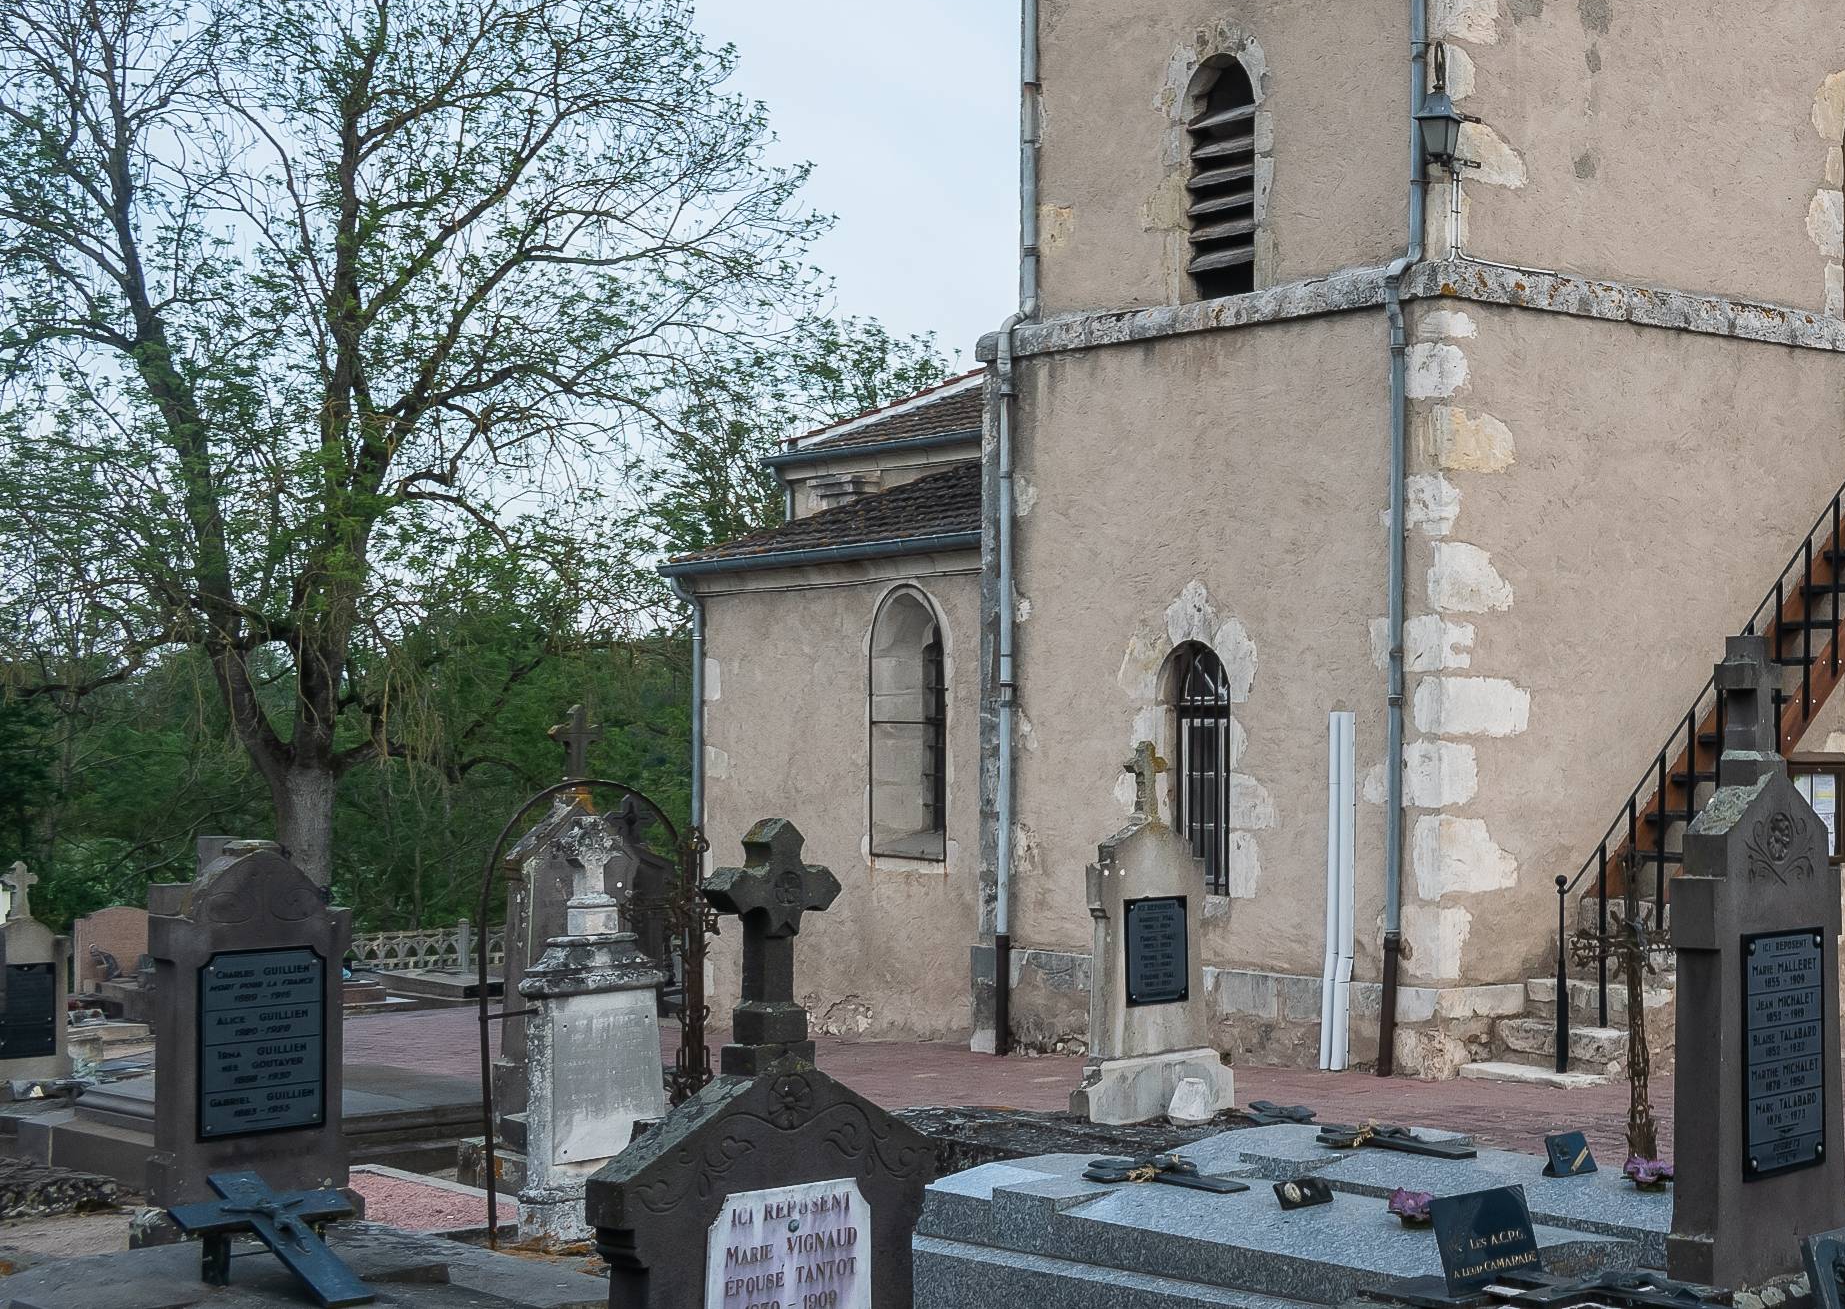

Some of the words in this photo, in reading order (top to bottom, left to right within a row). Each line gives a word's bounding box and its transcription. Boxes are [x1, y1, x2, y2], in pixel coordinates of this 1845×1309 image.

[1762, 942, 1771, 953] ICI
[1775, 938, 1807, 951] REPOSENT
[215, 970, 255, 979] CHARLES
[263, 964, 310, 976] GUILLIEN
[1751, 964, 1774, 977] MARIE
[239, 981, 263, 990] POUR
[281, 977, 316, 986] FRANCE
[1755, 999, 1773, 1011] JEAN
[1777, 992, 1814, 1008] MICHALET
[216, 1016, 246, 1025] ALICE
[259, 1009, 308, 1021] GUILLIEN
[1753, 1033, 1775, 1046] BLAISE
[1780, 1025, 1817, 1042] TALABARD
[217, 1051, 242, 1060] IRMA
[257, 1042, 307, 1056] GUILLIEN
[1751, 1067, 1778, 1082] MARTHE
[1782, 1058, 1818, 1076] MICHALET
[209, 1096, 251, 1108] GABRIEL
[266, 1088, 315, 1101] GUILLIEN
[1780, 1092, 1817, 1109] TALABARD
[731, 1208, 754, 1228] ICI
[763, 1191, 851, 1221] REPOSENT
[724, 1244, 774, 1268] MARIE
[786, 1226, 858, 1255] VIGNAUD
[1469, 1237, 1487, 1250] LES
[795, 1256, 857, 1285] TANTOT
